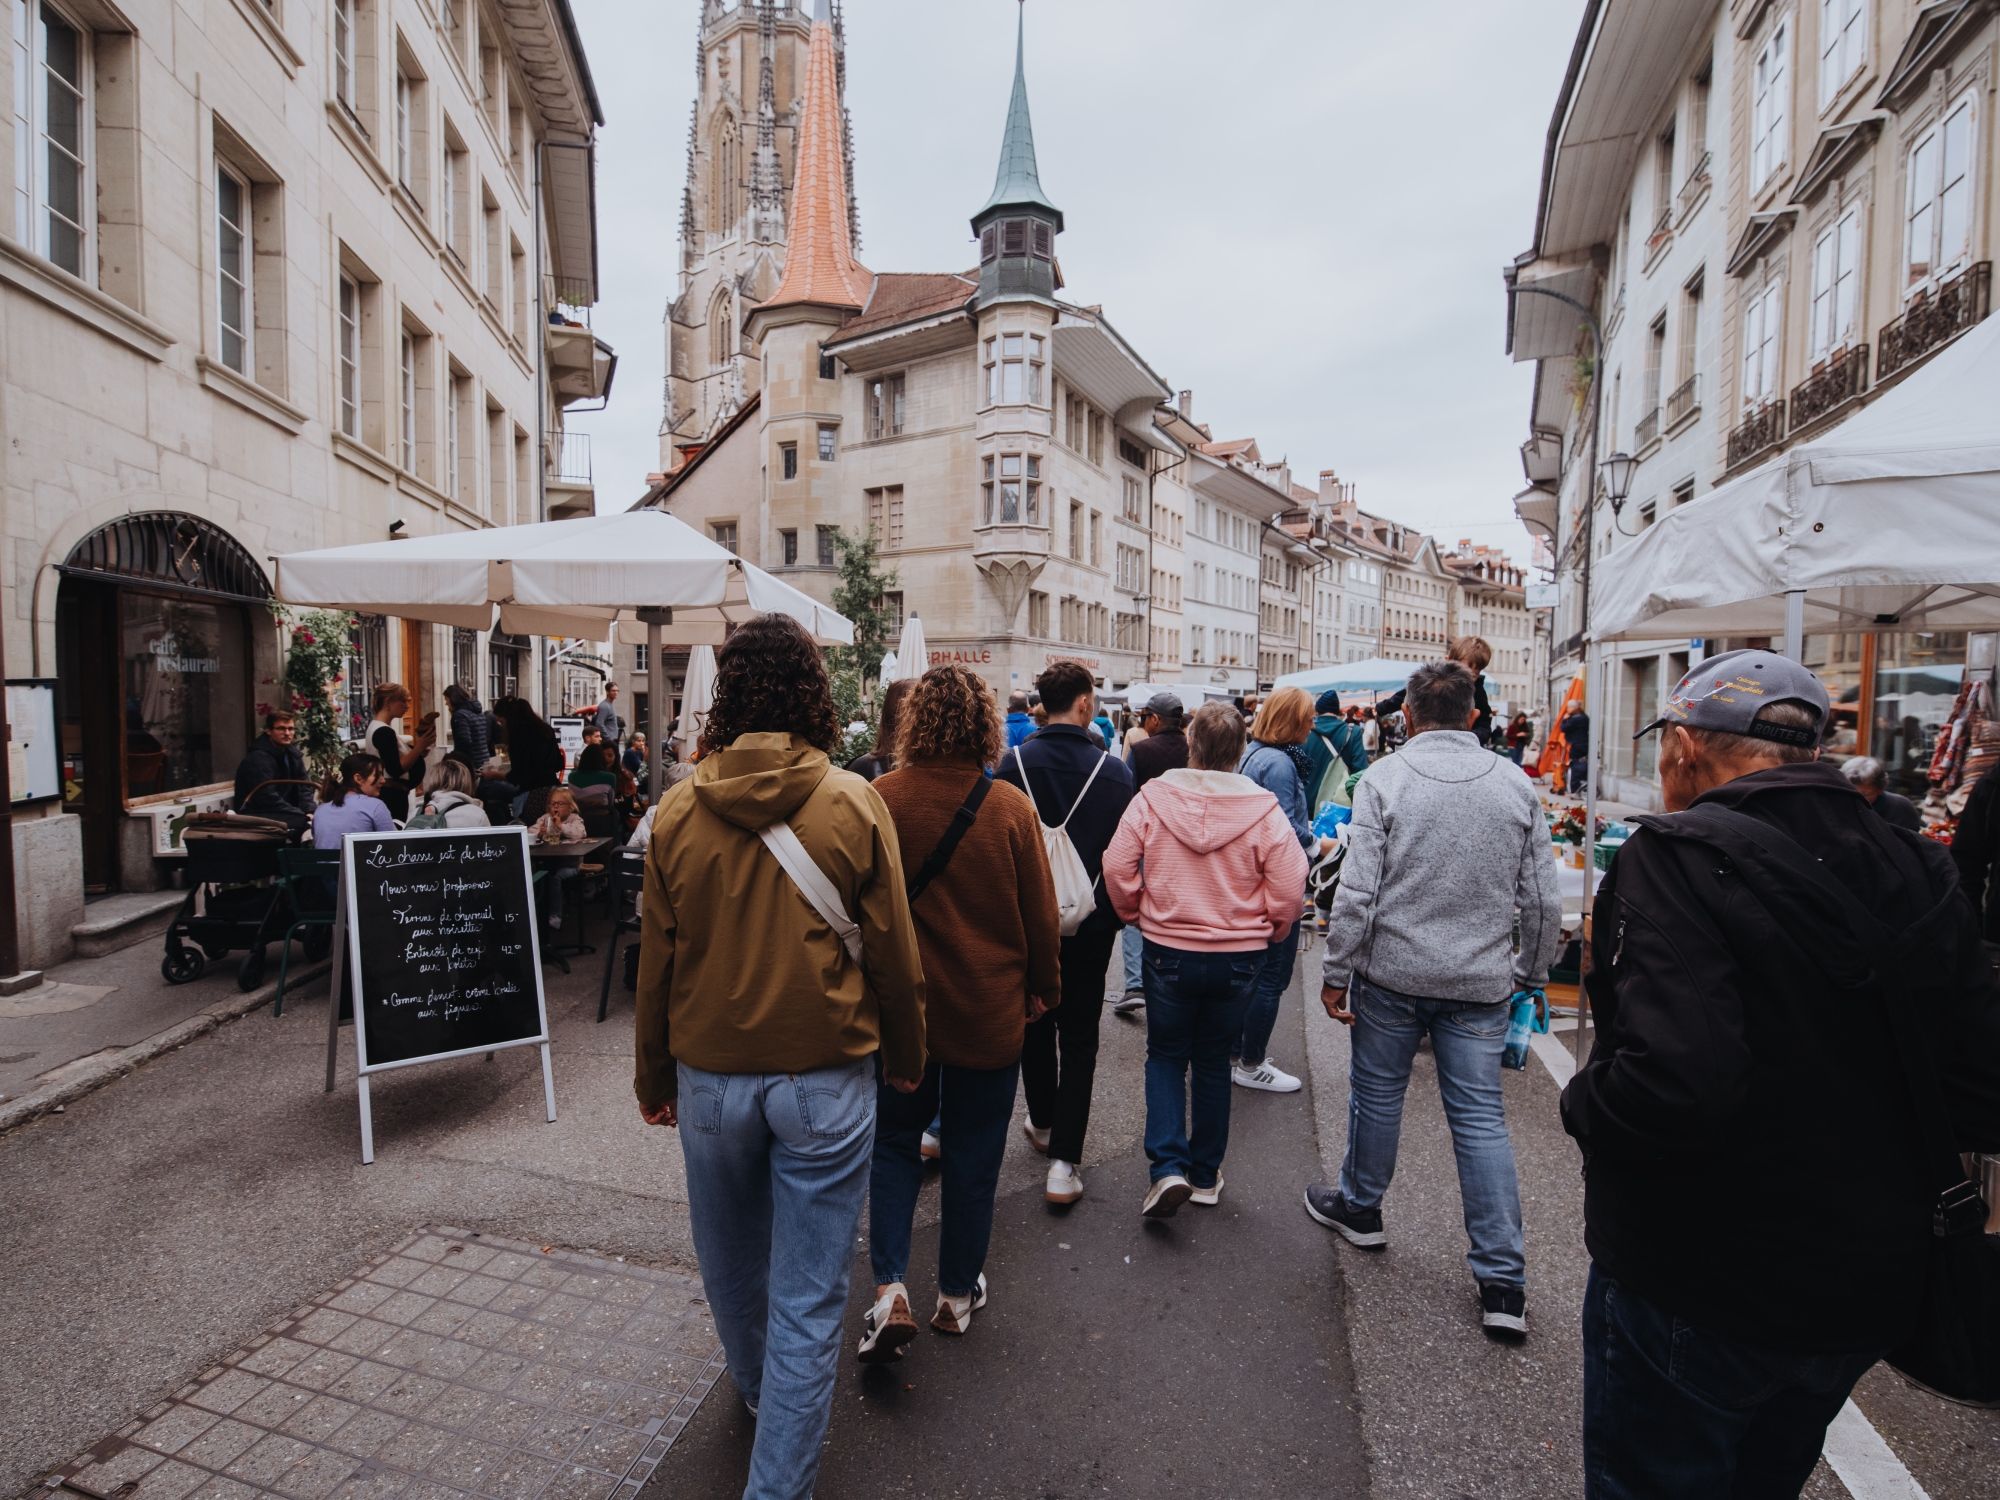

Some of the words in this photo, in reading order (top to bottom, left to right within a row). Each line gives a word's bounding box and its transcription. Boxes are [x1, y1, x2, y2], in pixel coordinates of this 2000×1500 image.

[149, 631, 177, 655] café
[157, 654, 220, 672] restaurant
[1755, 723, 1793, 740] ROUTE
[367, 844, 391, 868] La
[438, 844, 456, 863] est
[460, 845, 475, 864] de
[477, 842, 506, 861] retour
[380, 880, 407, 901] Nous
[411, 881, 439, 893] vous
[439, 908, 451, 925] de
[412, 928, 434, 939] aux
[451, 943, 464, 957] de
[420, 963, 440, 973] aux
[390, 992, 423, 1007] Comme
[418, 1009, 438, 1020] aux
